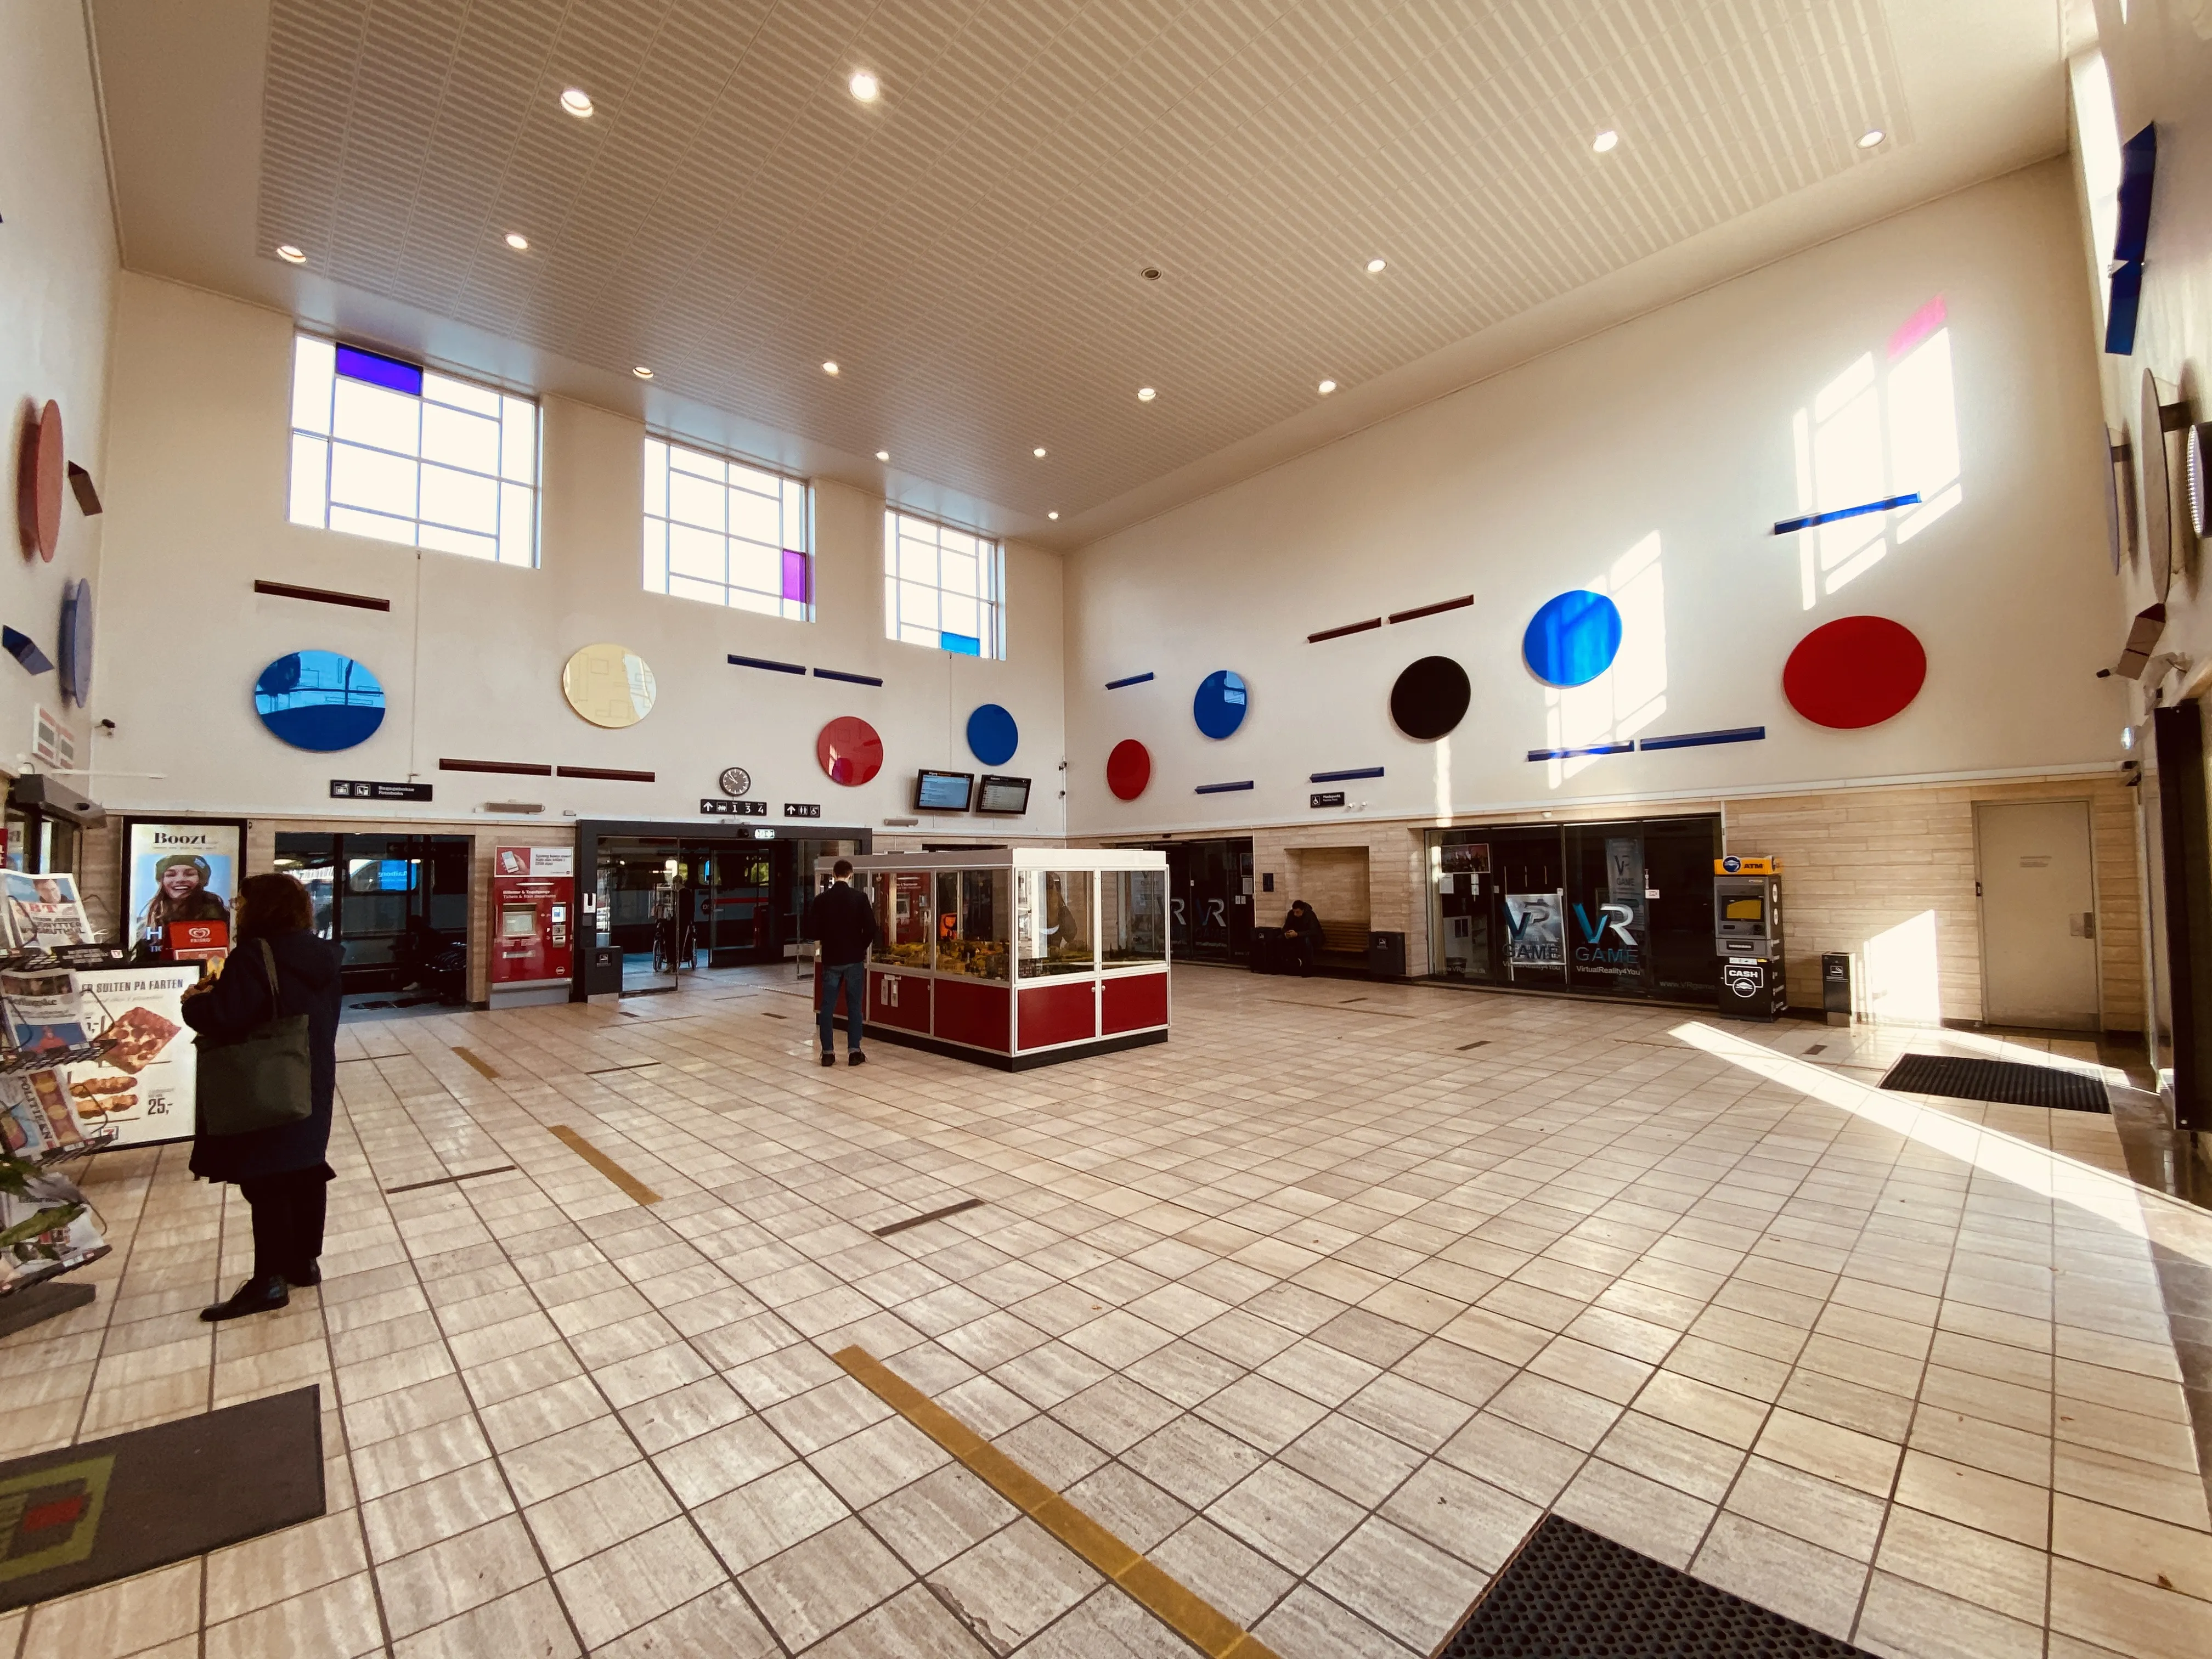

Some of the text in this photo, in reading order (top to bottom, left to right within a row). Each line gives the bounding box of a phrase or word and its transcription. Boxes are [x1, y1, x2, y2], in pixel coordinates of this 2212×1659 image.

[745, 805, 751, 814] 3
[153, 832, 207, 844] Boozt
[1572, 902, 1638, 946] VR
[1503, 943, 1560, 960] GAME
[1575, 947, 1639, 964] GAME
[1576, 966, 1641, 975] VirtualReality4You
[1729, 970, 1758, 978] CASH
[96, 981, 131, 993] SULTEN
[149, 979, 183, 990] FARTEN
[148, 1098, 173, 1115] 25,-
